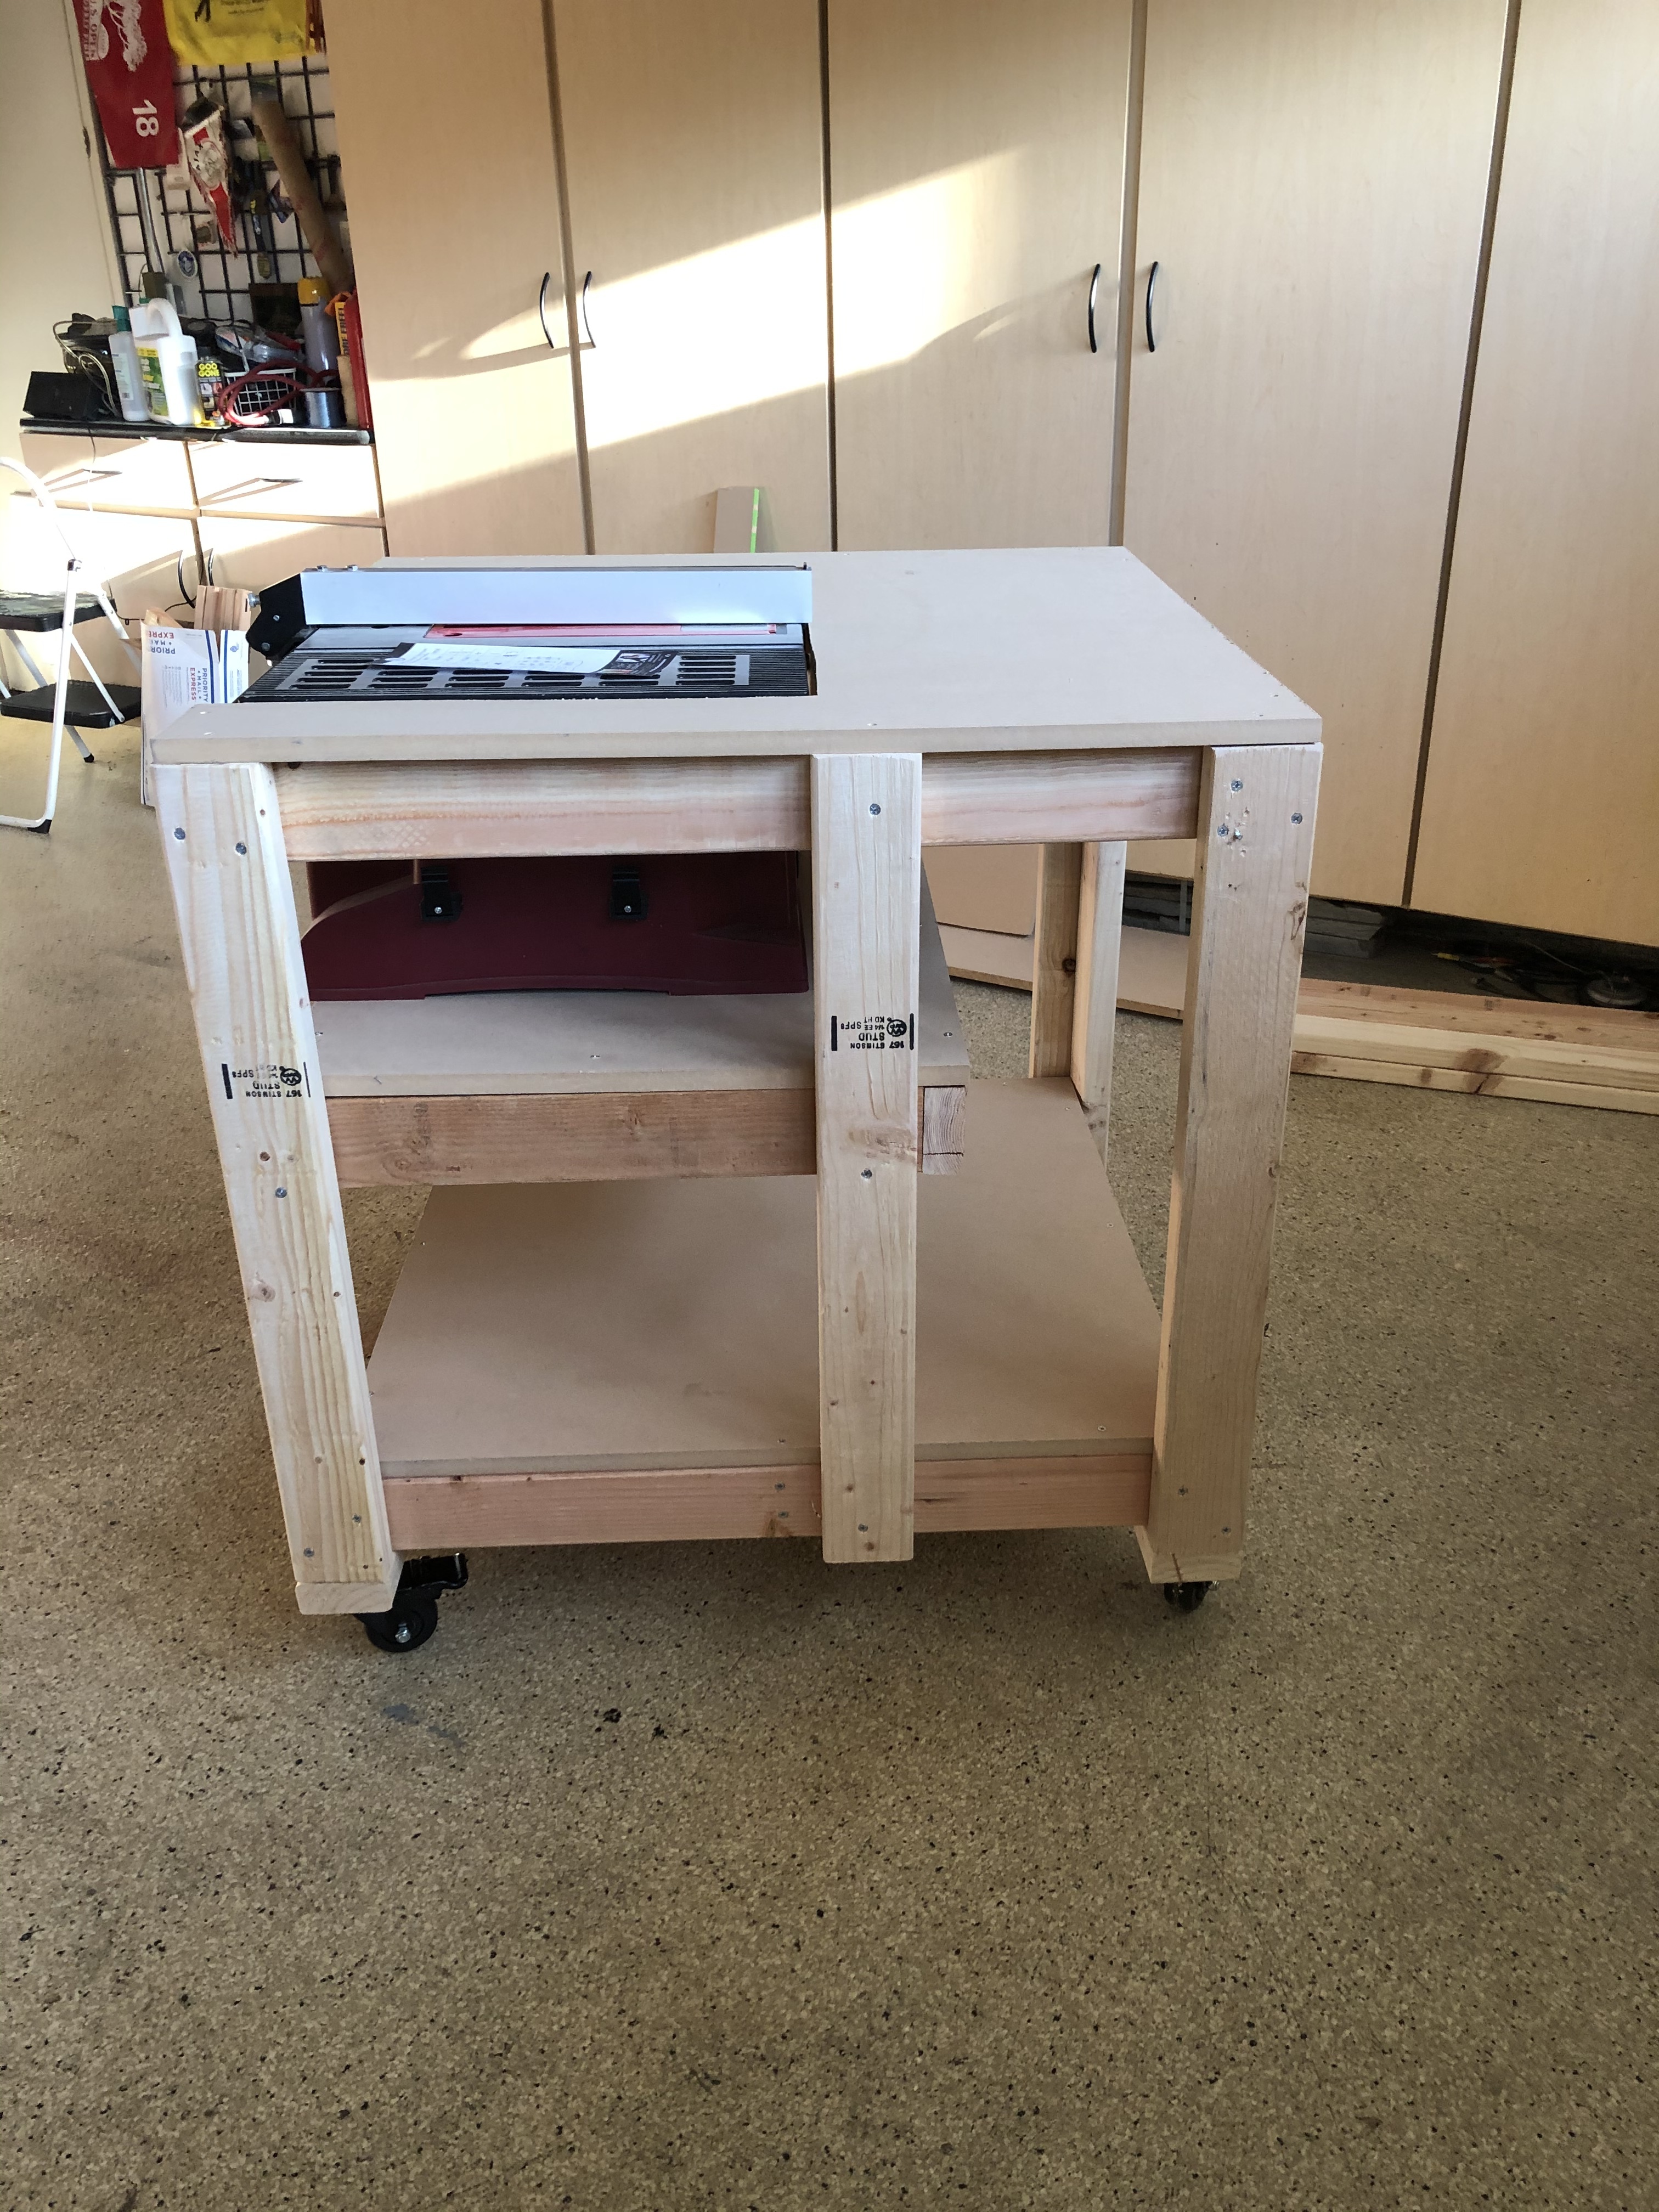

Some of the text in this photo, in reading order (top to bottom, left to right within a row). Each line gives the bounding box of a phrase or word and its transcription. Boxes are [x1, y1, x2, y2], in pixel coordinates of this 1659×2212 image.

[132, 99, 159, 137] 18
[199, 363, 218, 371] GOO
[859, 1032, 885, 1041] STUD
